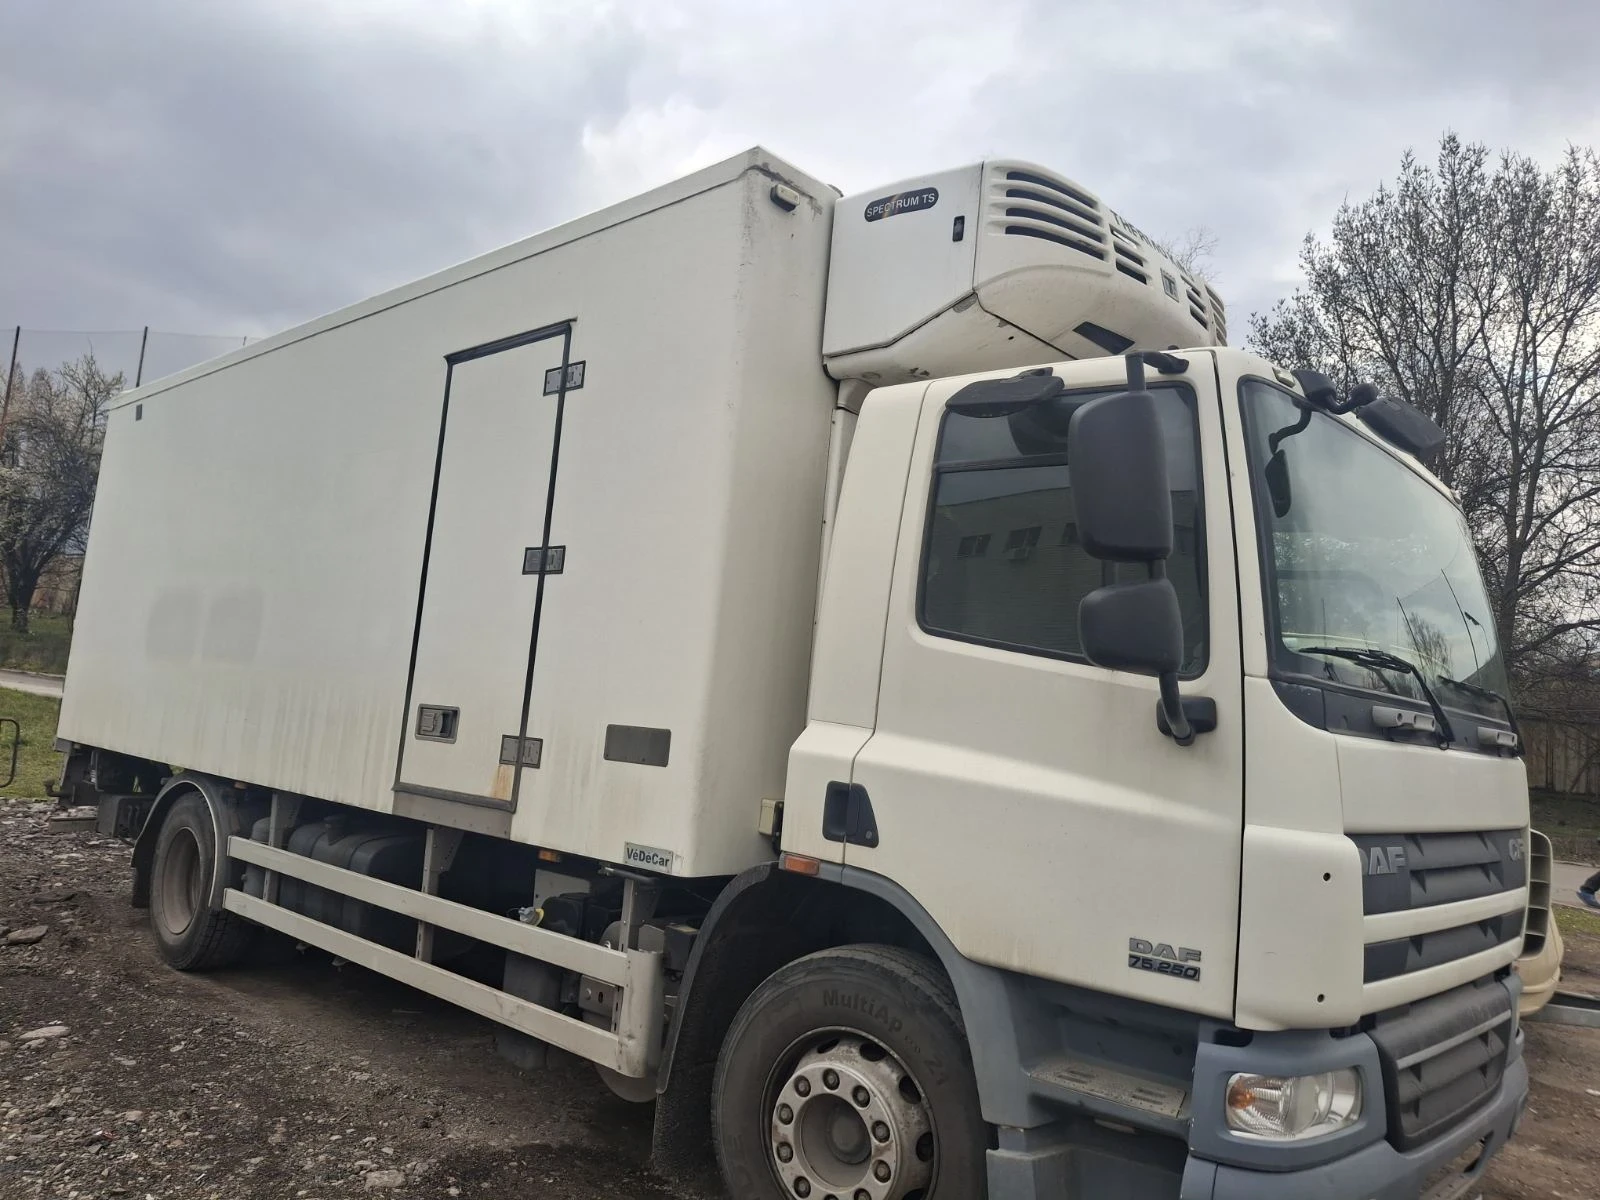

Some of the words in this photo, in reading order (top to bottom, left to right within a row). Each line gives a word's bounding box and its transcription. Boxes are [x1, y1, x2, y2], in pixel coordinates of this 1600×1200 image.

[866, 195, 919, 217] SPECTRUM
[922, 193, 935, 204] TS
[1129, 937, 1201, 962] DAF
[1129, 954, 1199, 979] 75.250
